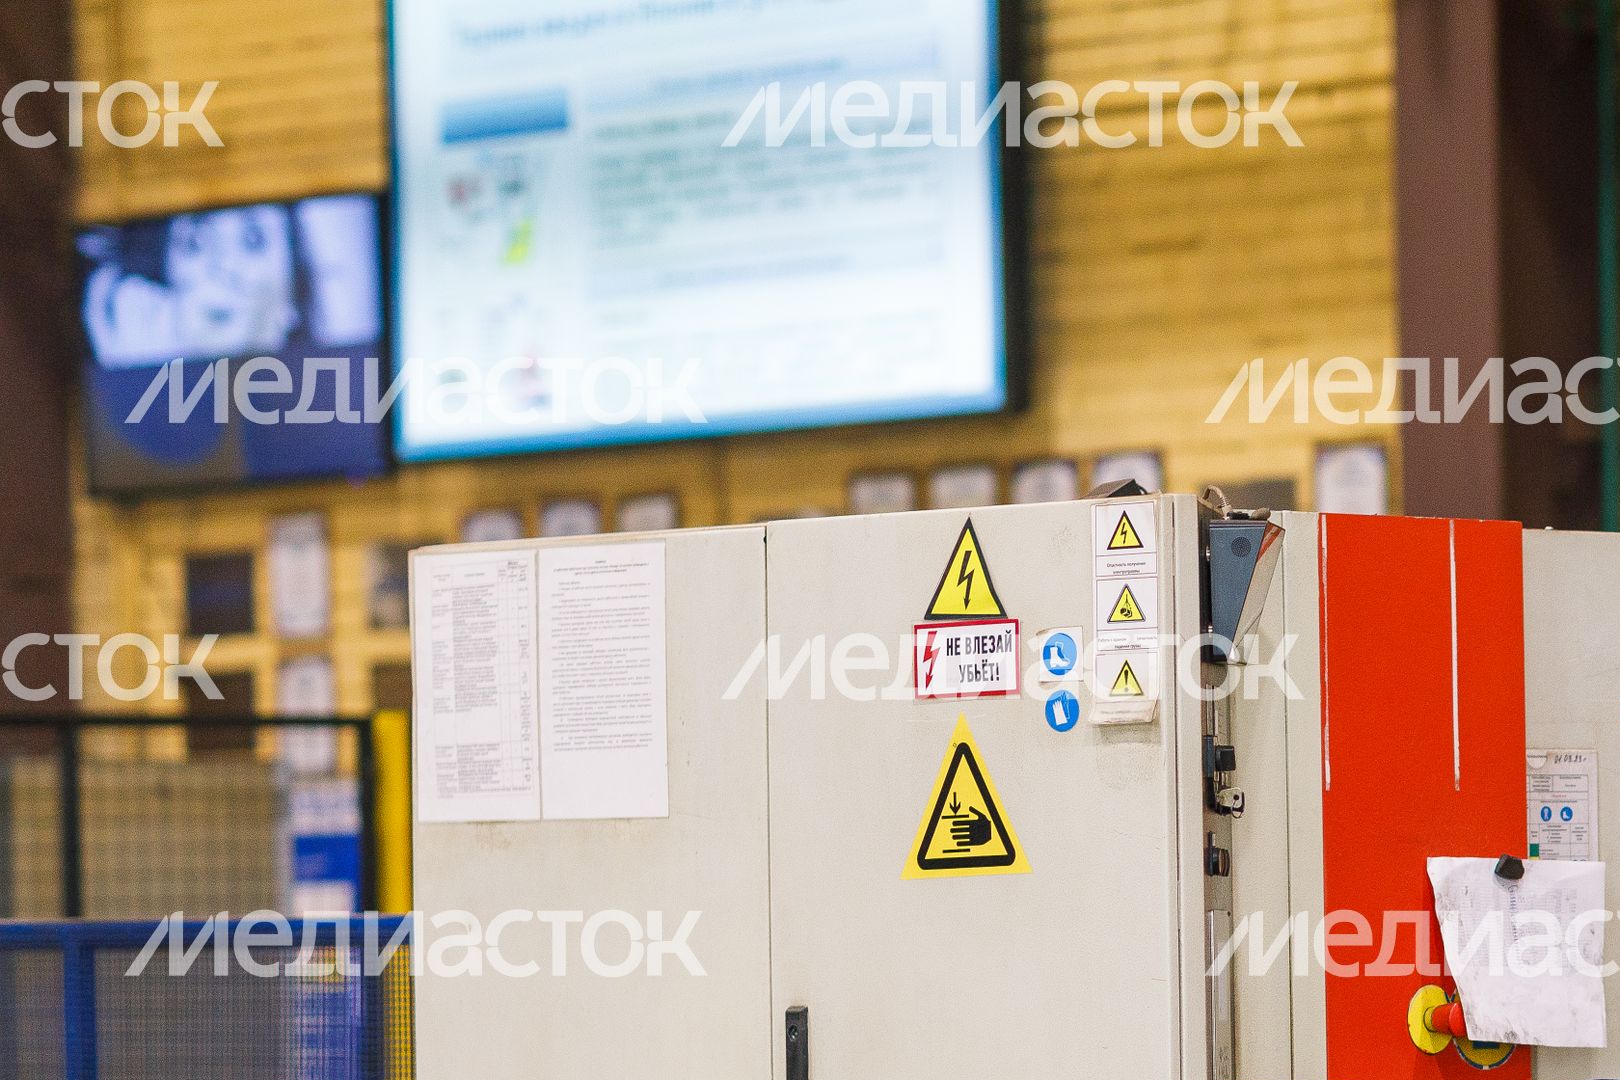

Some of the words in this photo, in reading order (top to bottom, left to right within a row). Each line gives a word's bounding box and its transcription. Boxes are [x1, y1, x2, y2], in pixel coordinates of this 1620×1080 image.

[946, 637, 961, 656] НЕ
[965, 629, 1013, 655] ВЛЕЗАЙ
[959, 659, 1000, 683] УБЬЁТ!
